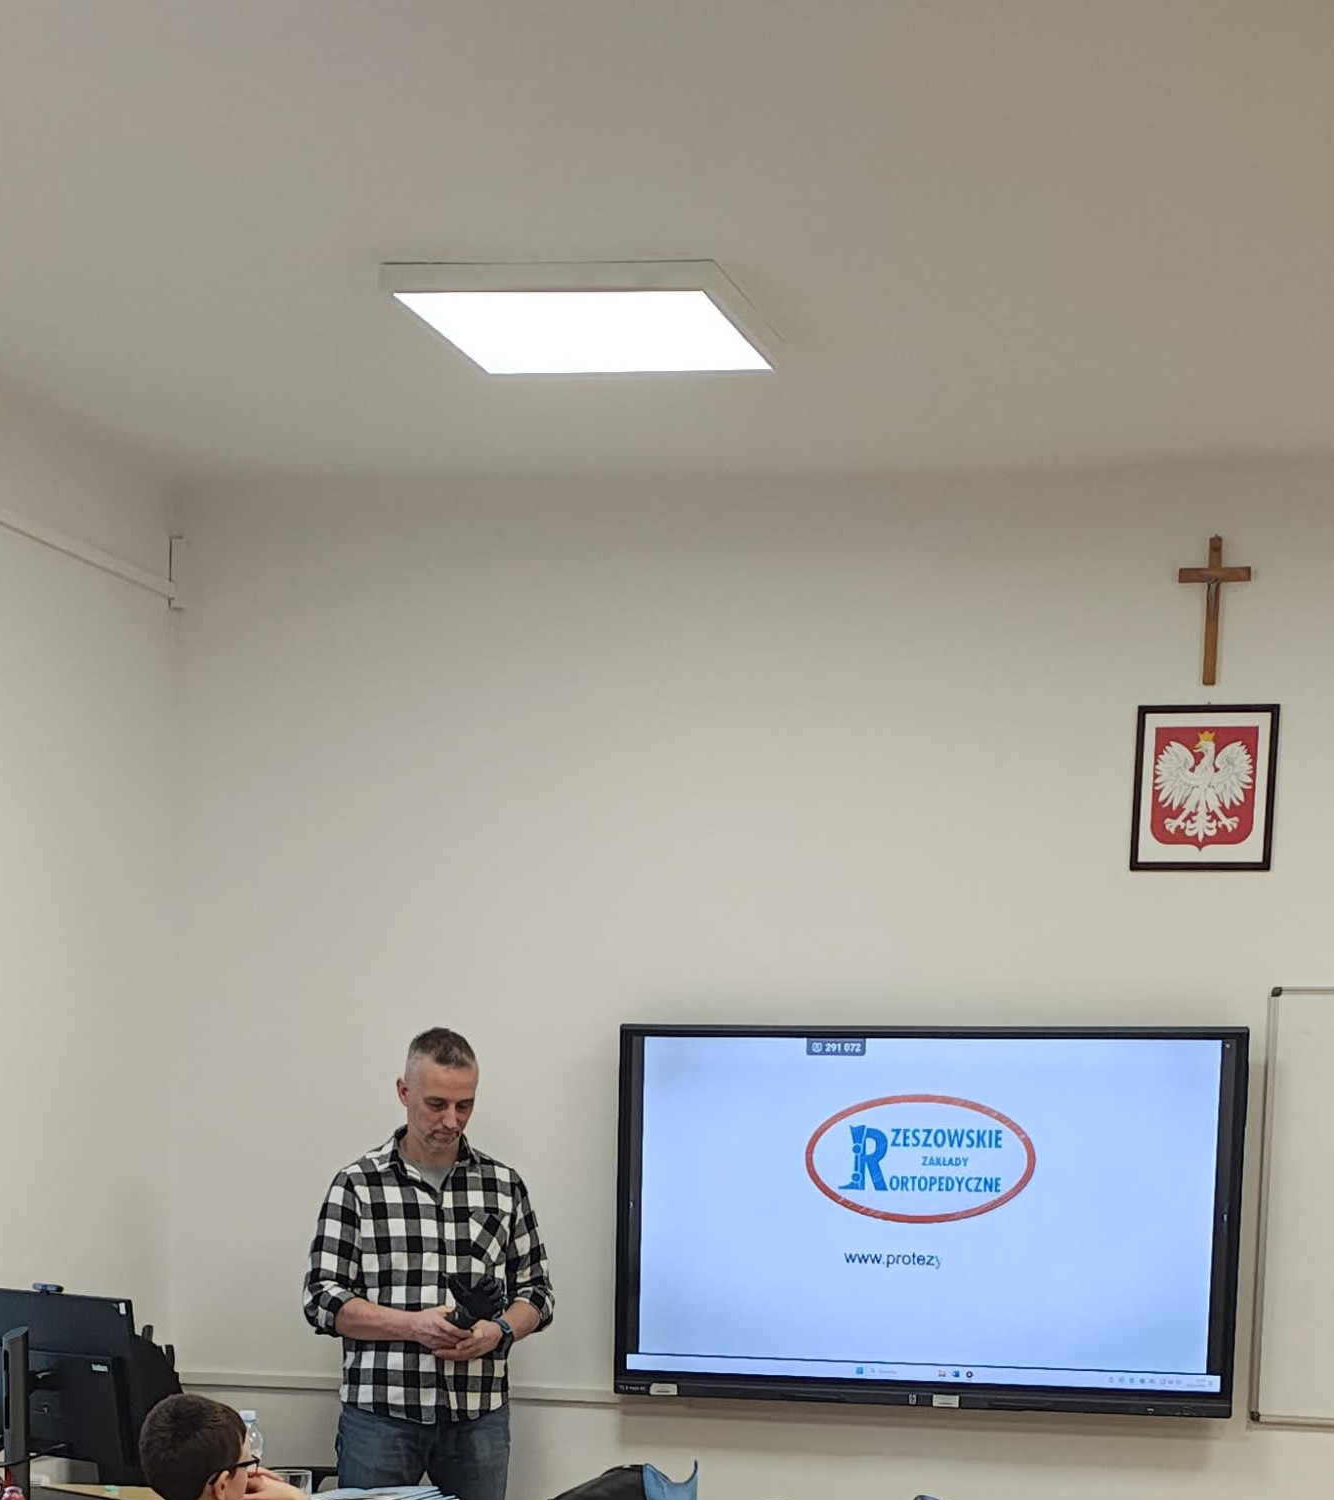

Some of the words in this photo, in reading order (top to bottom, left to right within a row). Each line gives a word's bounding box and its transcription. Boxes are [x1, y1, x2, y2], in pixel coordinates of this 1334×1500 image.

[824, 1042, 842, 1053] 291
[921, 1156, 969, 1167] ZAKŁADY
[889, 1175, 1002, 1193] ORTOPEDYCZNE
